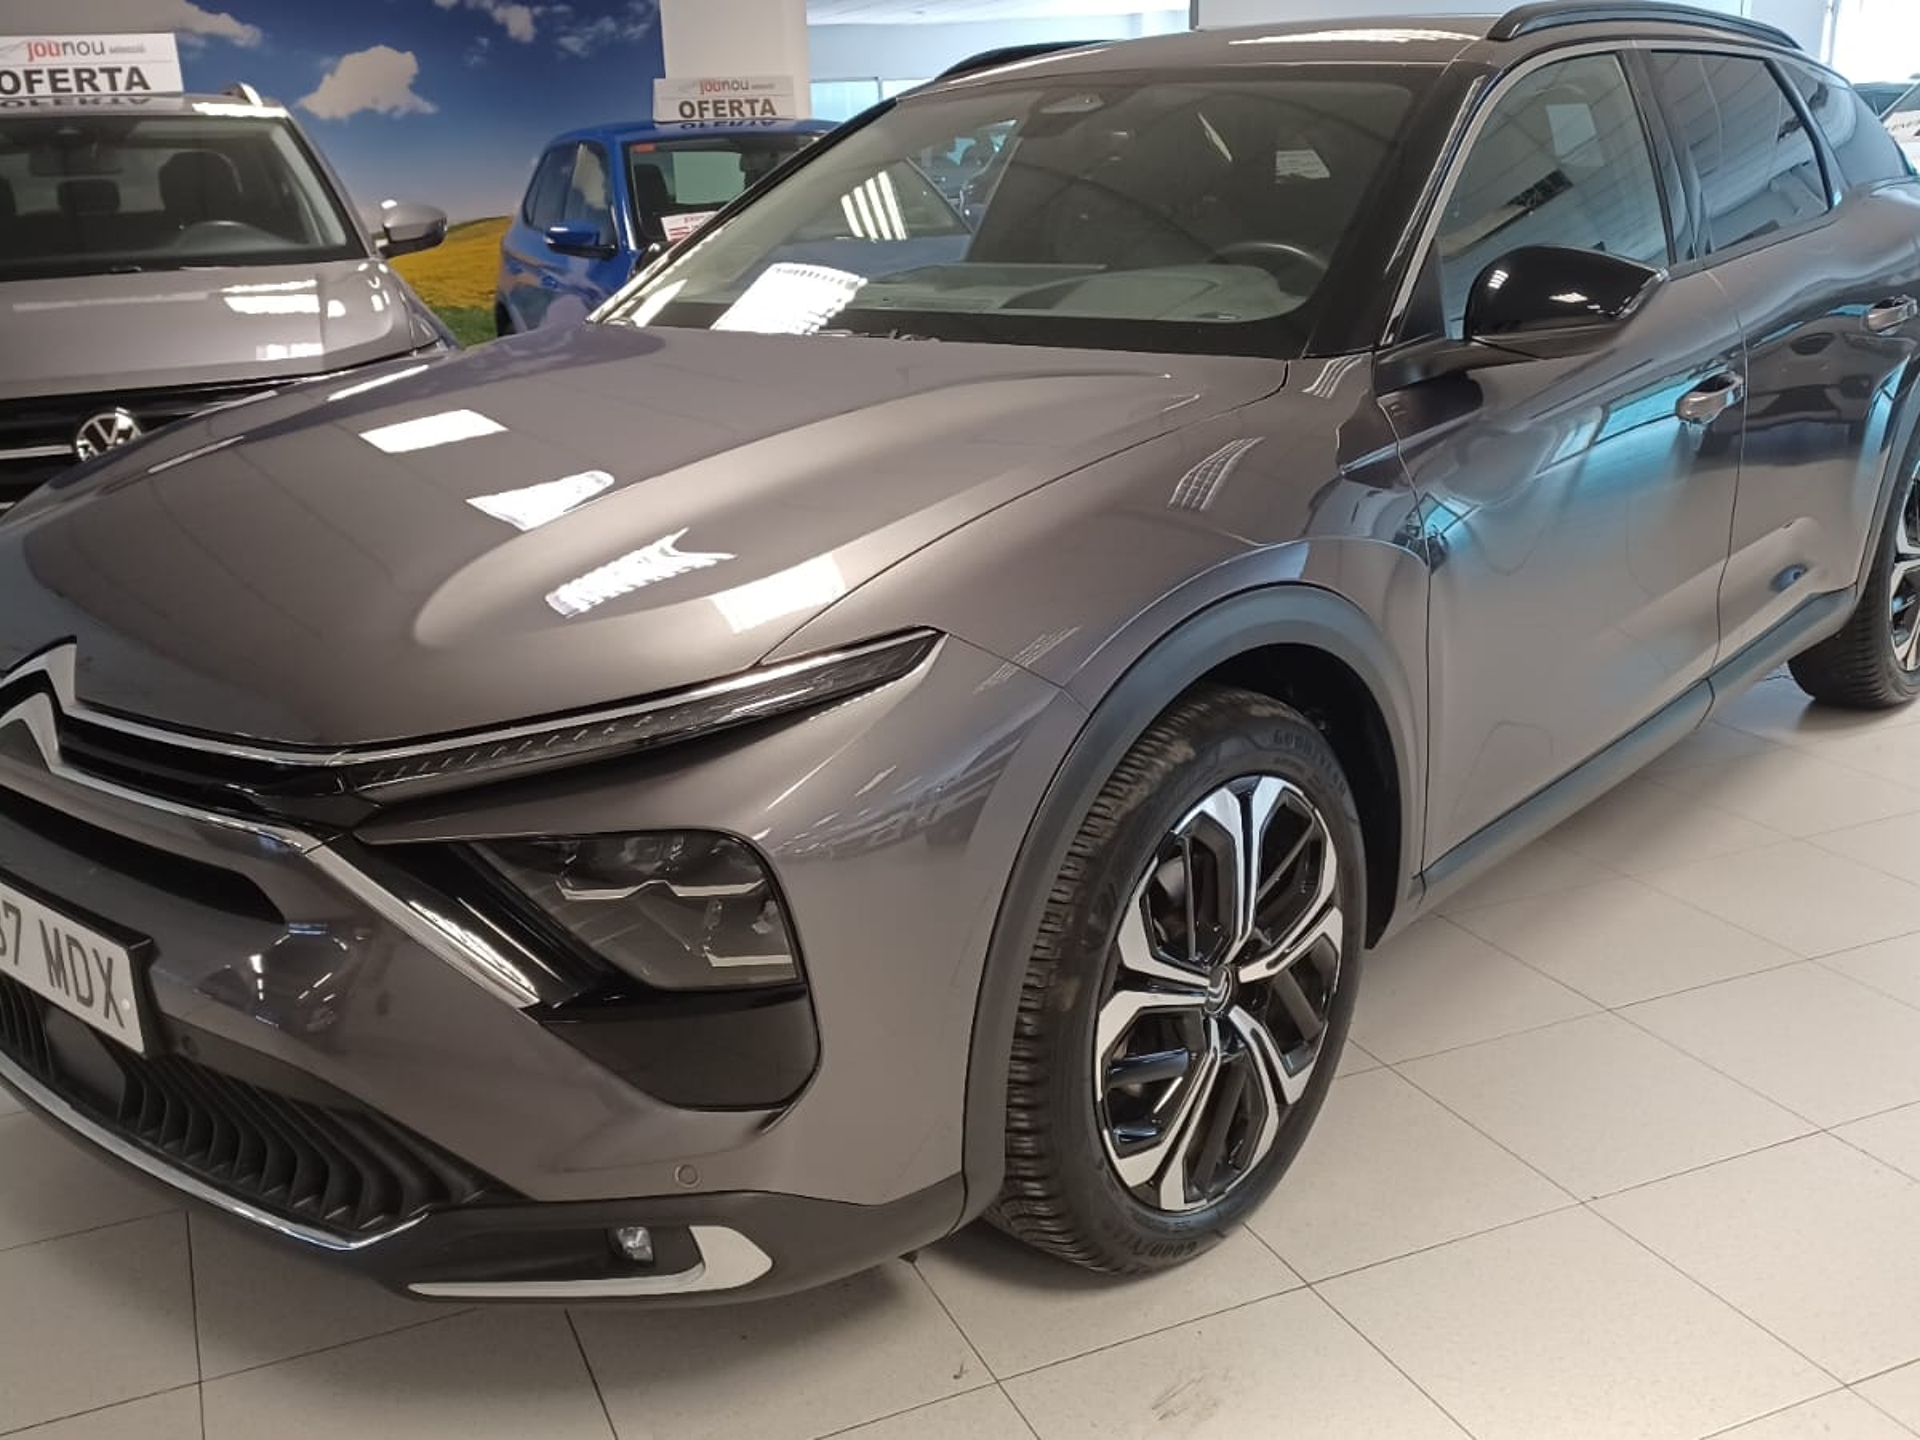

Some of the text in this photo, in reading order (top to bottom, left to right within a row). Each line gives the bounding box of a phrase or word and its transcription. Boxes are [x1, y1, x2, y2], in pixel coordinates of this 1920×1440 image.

[0, 66, 151, 95] OFERTA
[678, 98, 776, 119] OFERTA
[38, 919, 125, 1029] MDX
